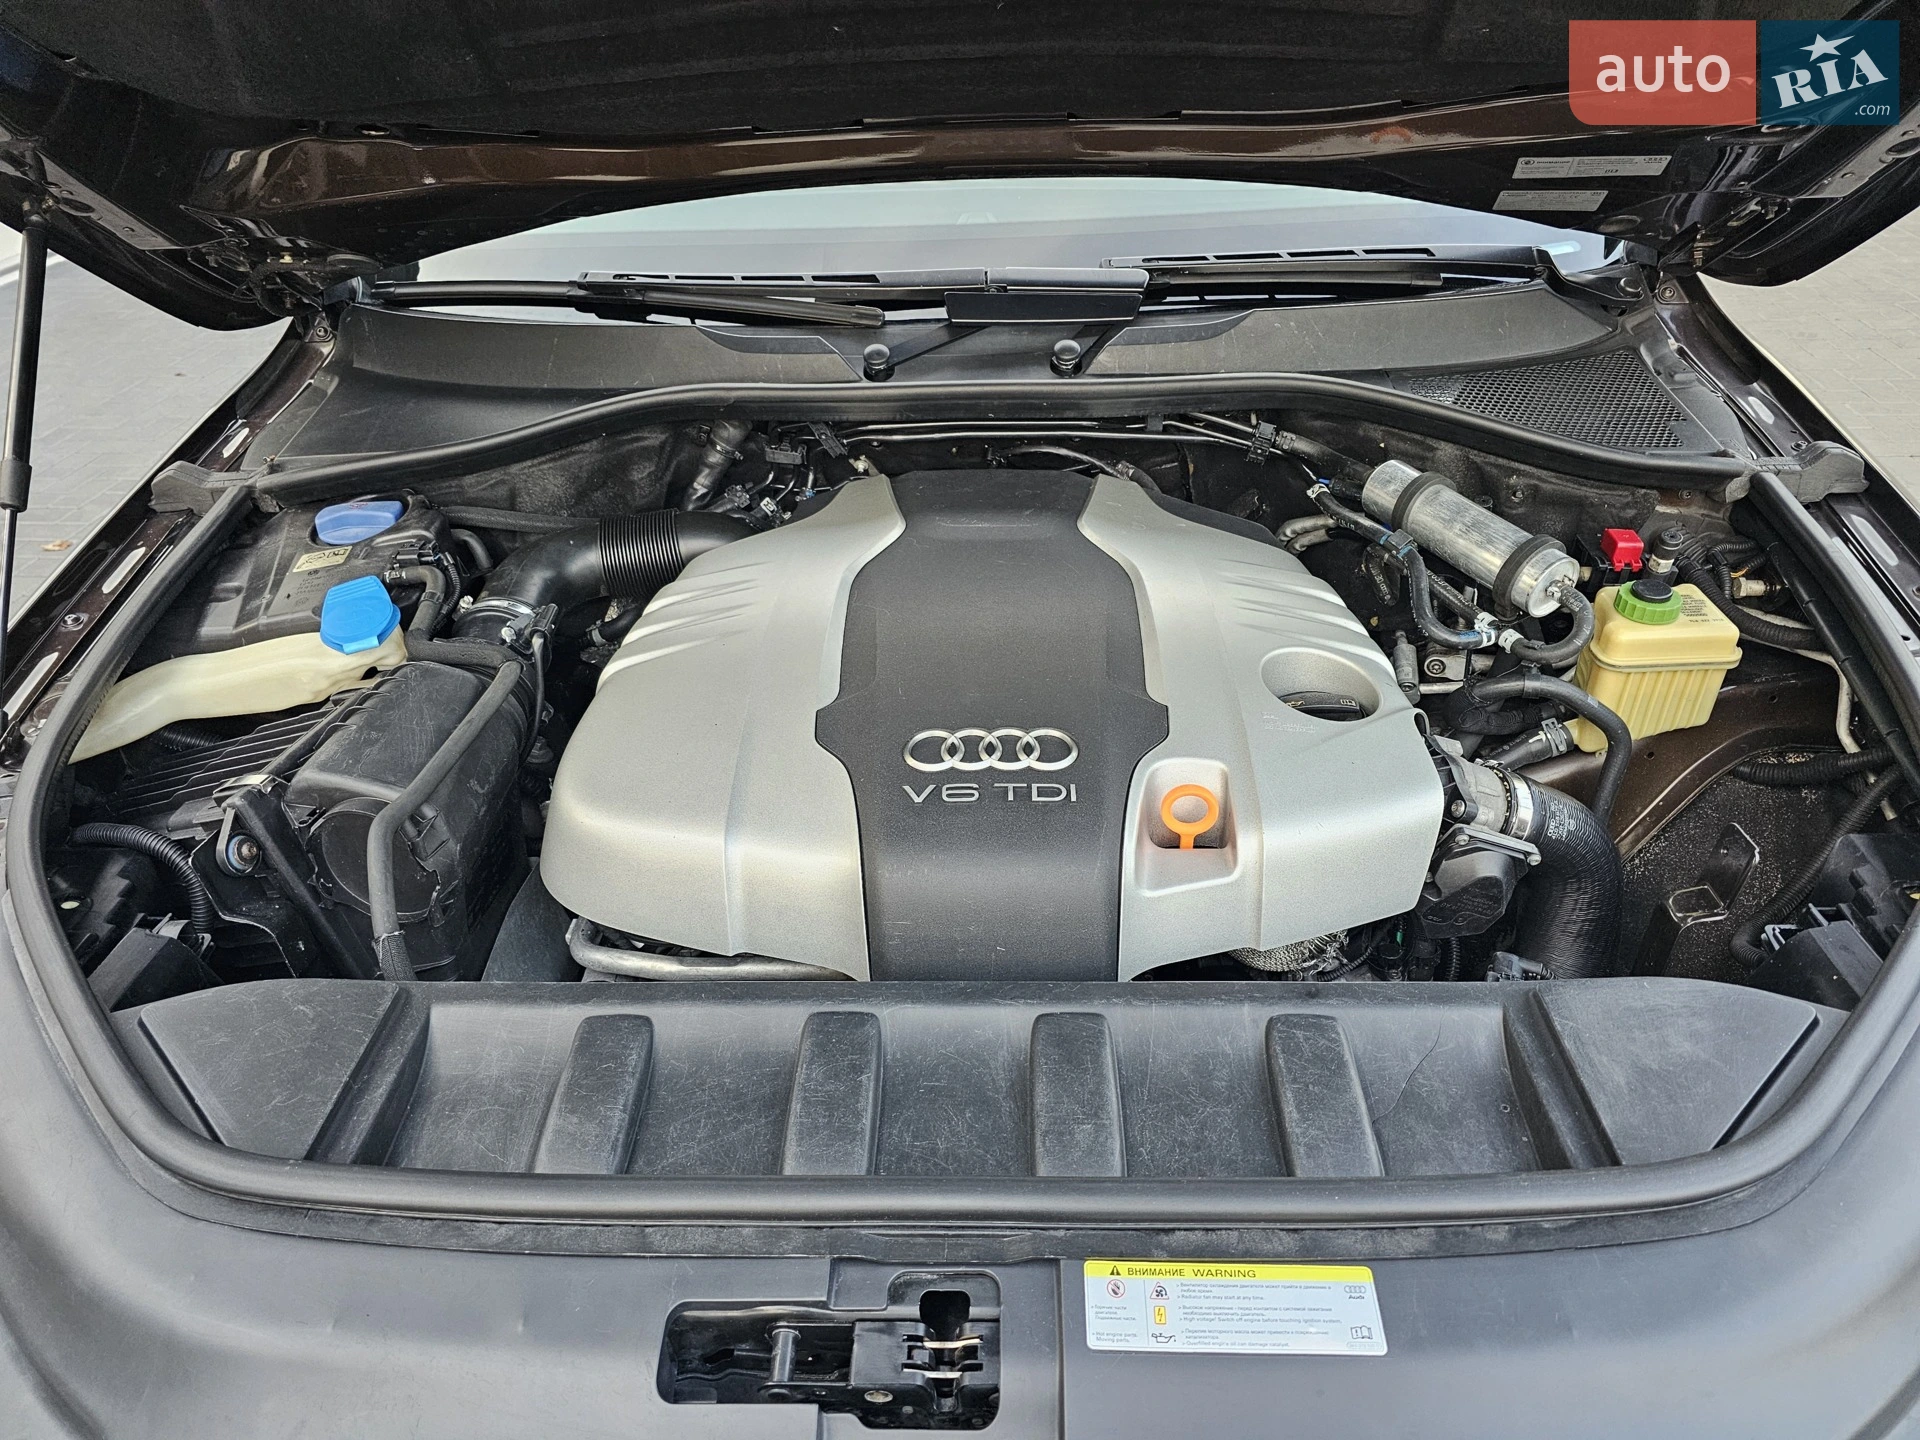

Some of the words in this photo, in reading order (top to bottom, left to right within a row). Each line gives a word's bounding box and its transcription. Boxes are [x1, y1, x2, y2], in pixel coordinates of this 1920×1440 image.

[902, 783, 980, 803] V6
[993, 783, 1077, 802] TDI
[1127, 1267, 1185, 1277] ВНИМАНИЕ
[1192, 1268, 1257, 1278] WARNING
